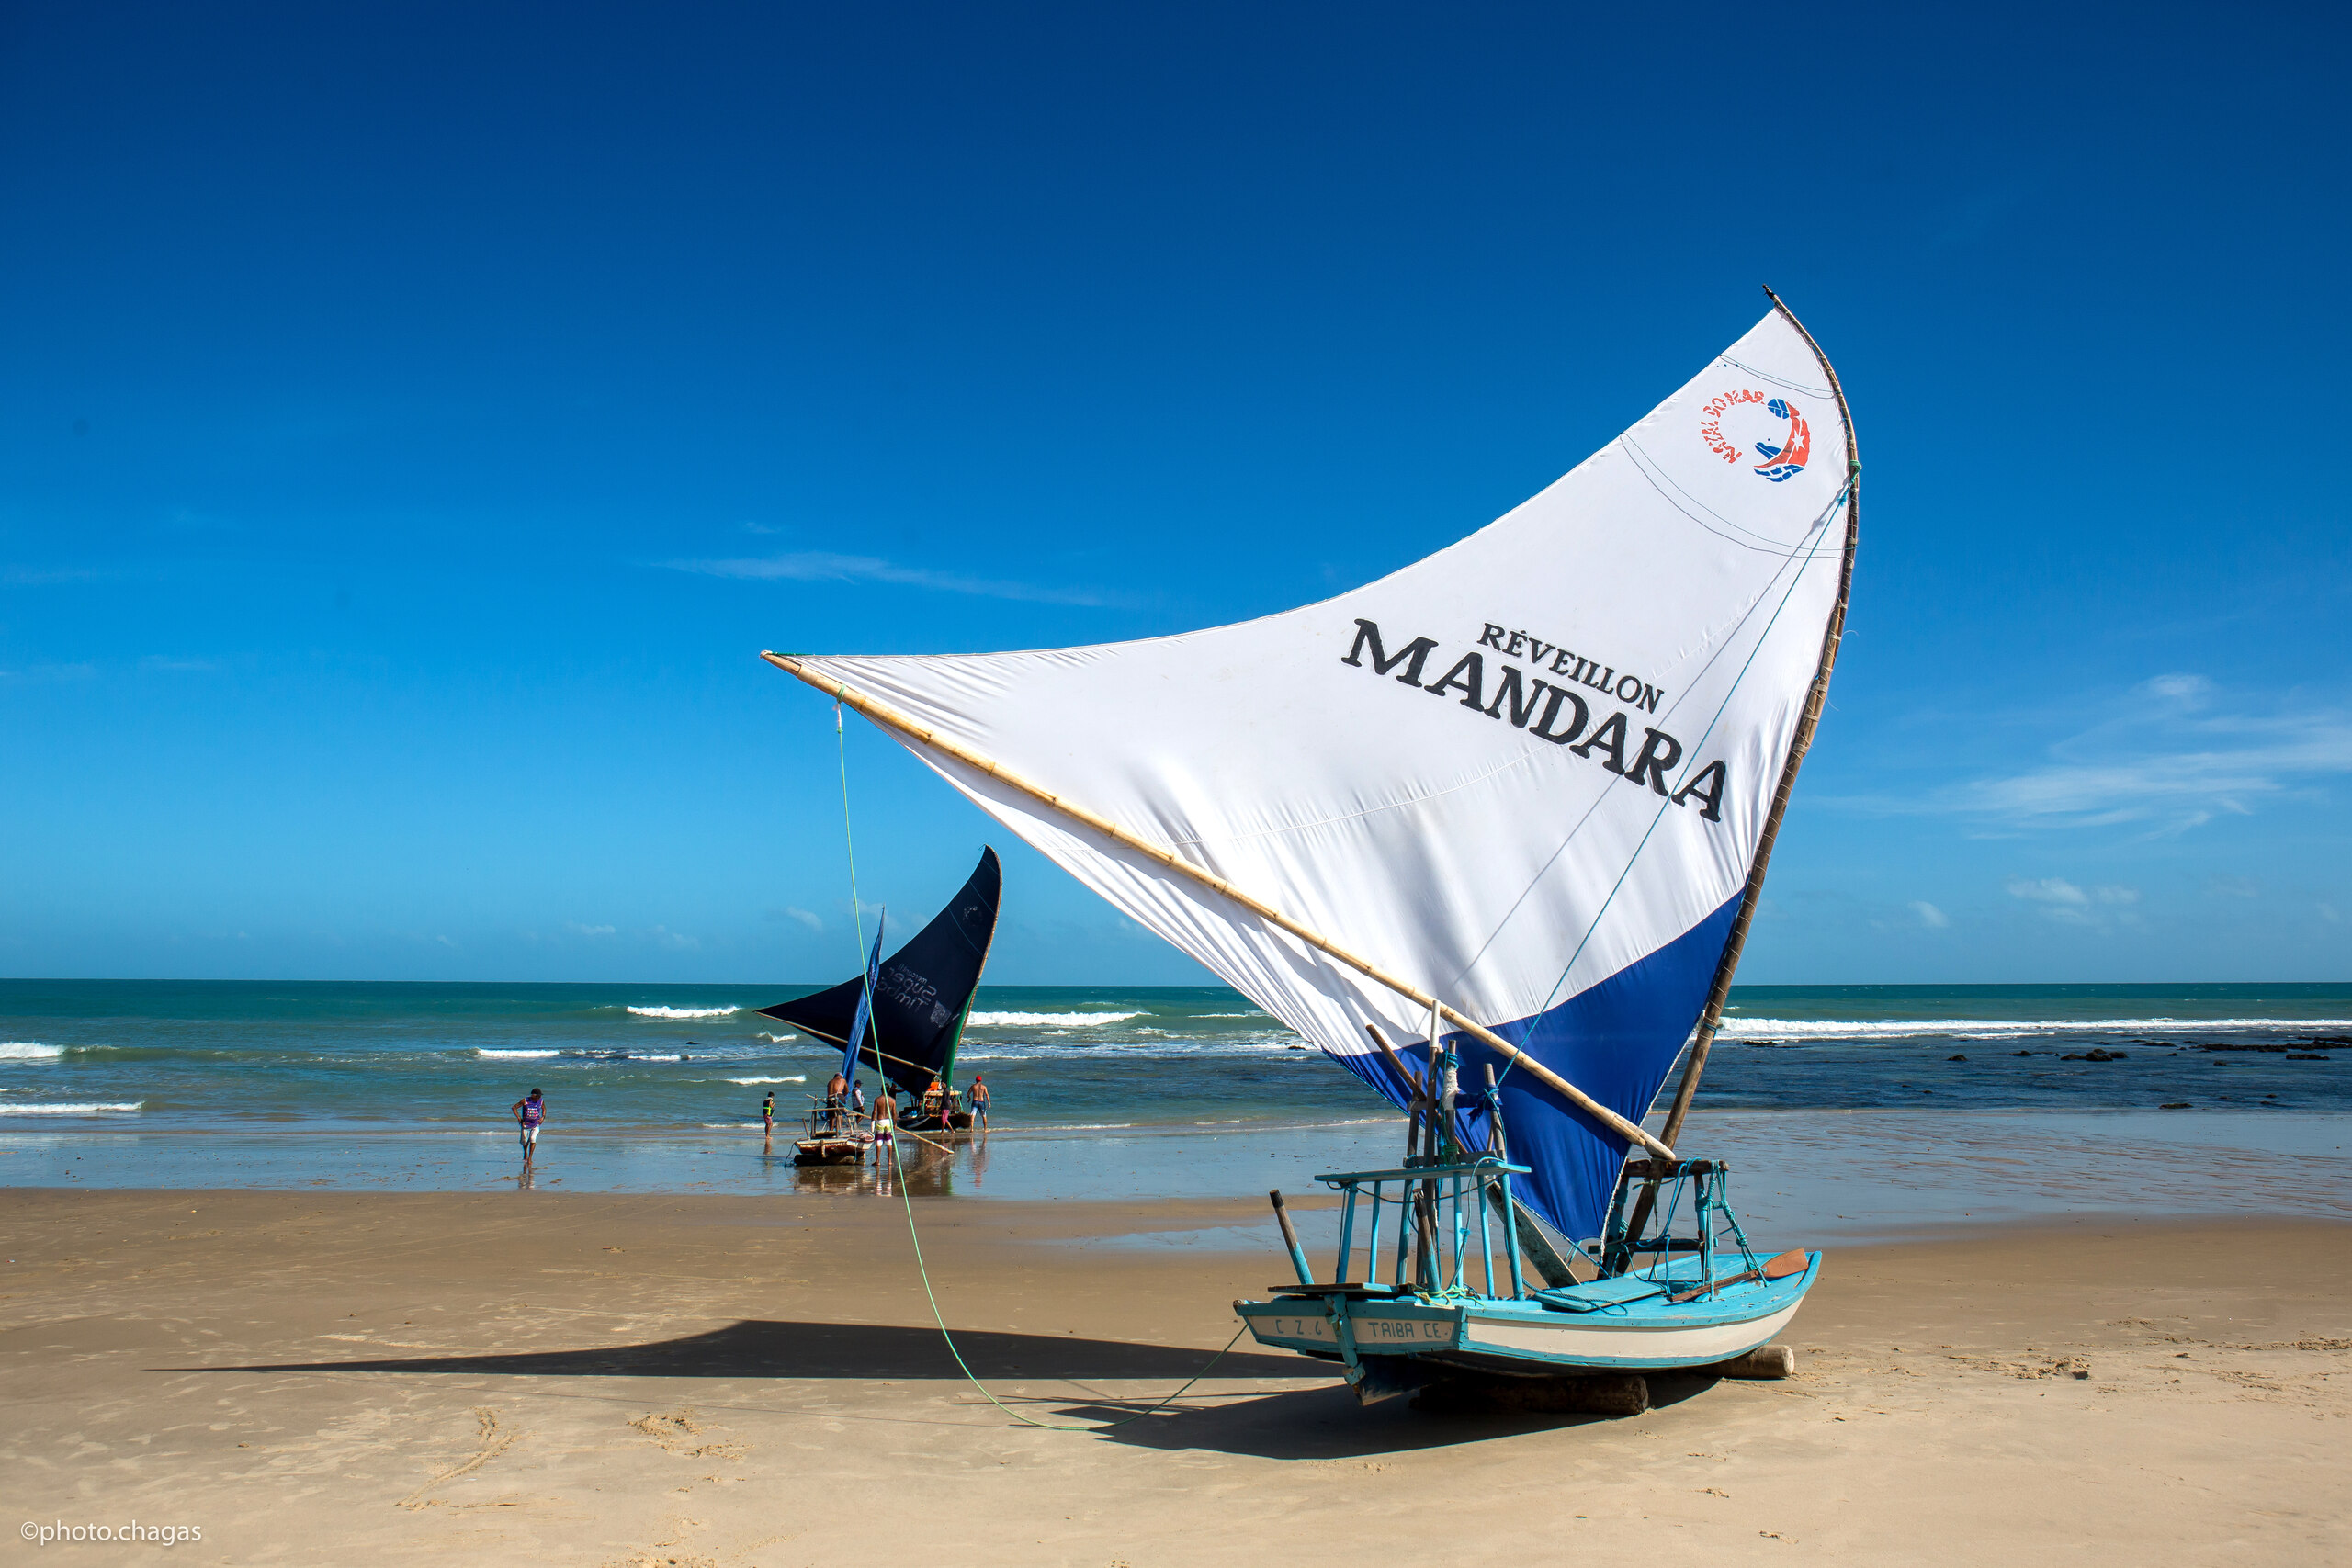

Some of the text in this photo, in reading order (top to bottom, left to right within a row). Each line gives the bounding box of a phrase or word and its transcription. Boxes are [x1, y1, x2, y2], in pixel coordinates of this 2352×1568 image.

[1476, 622, 1665, 714] RÉVEILLON
[1340, 618, 1727, 823] MANDARA
[1367, 1322, 1415, 1338] TAIBA
